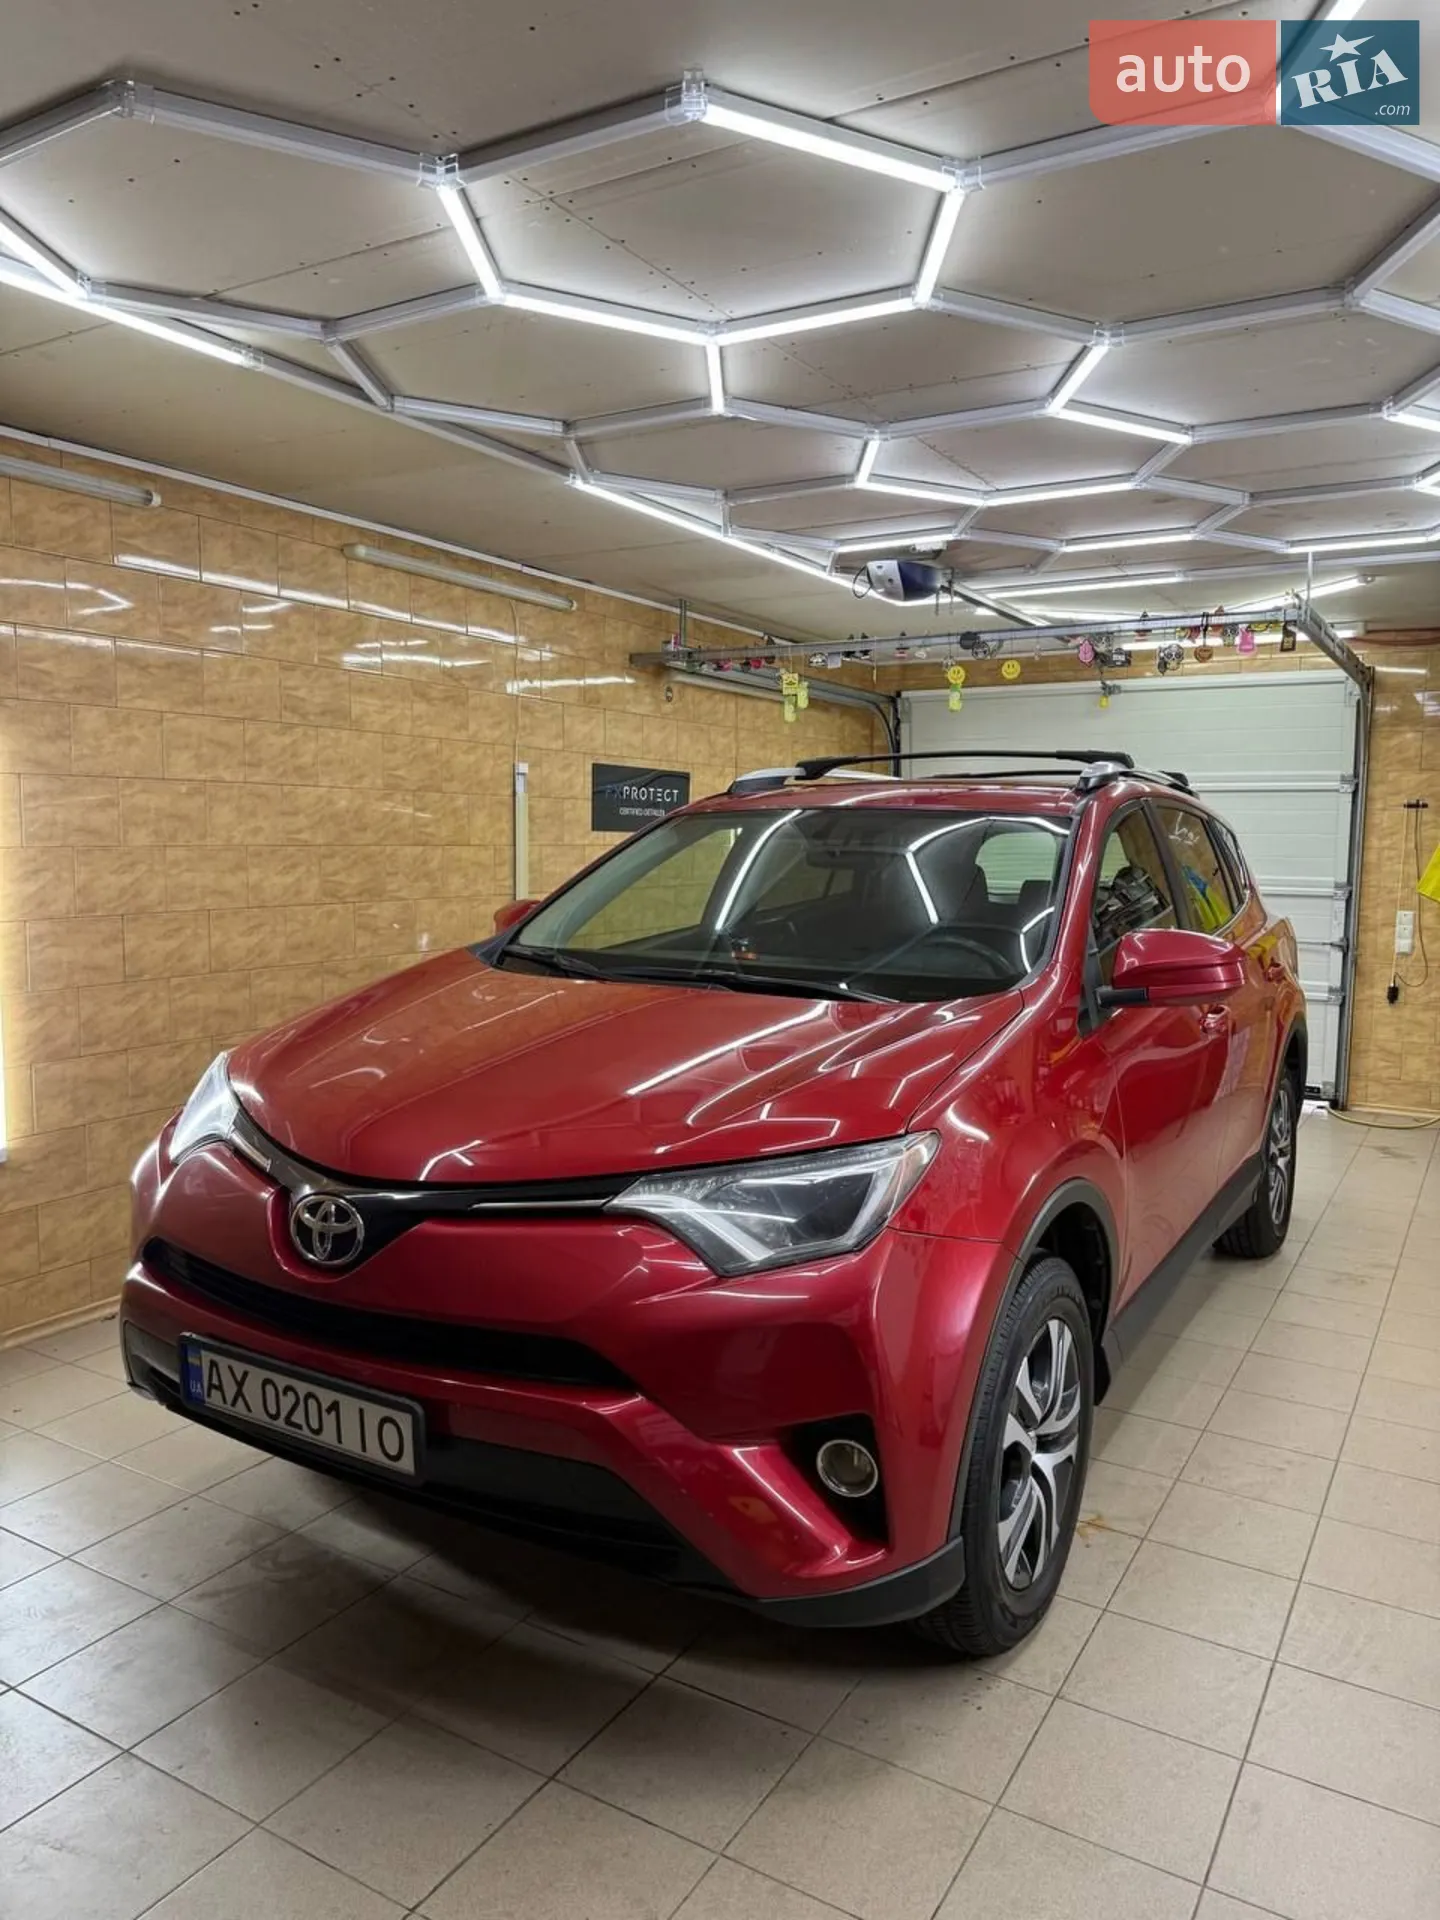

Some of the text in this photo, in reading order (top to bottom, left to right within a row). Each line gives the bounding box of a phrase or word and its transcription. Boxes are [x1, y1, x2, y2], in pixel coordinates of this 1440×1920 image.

[190, 1379, 202, 1394] UA
[206, 1359, 404, 1463] AX 0201 IO
